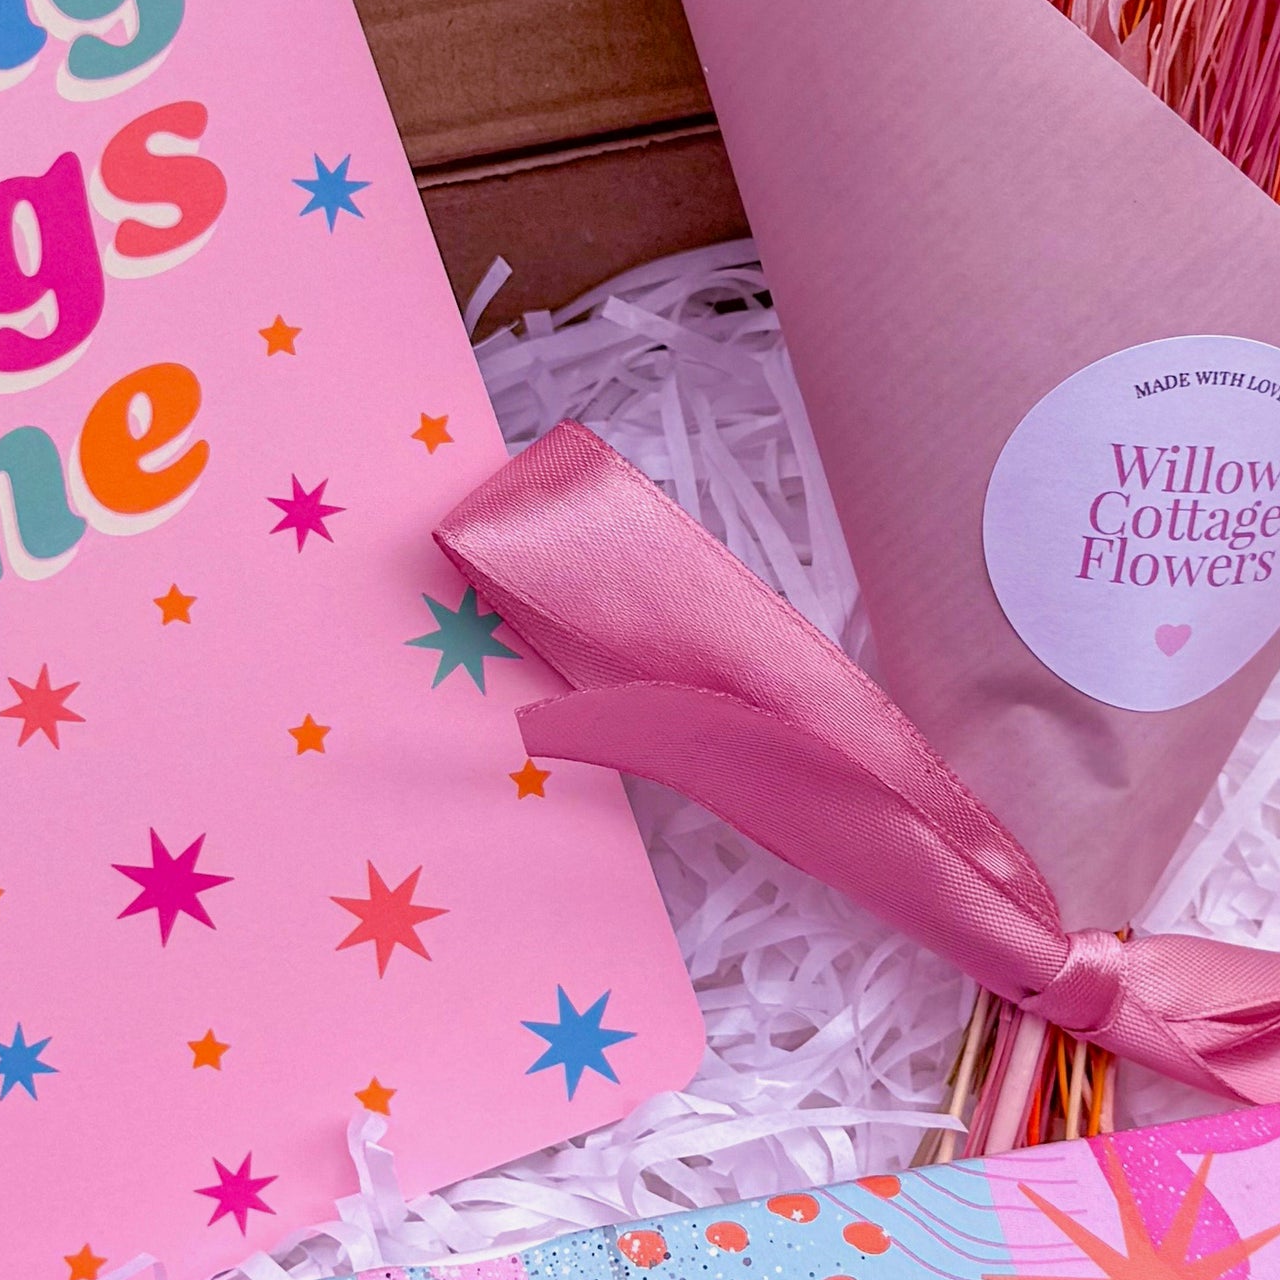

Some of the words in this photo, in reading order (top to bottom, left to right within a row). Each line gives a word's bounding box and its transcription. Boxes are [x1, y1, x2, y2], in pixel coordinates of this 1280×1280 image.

[1134, 372, 1190, 399] MADE
[1195, 370, 1246, 387] WITH
[1074, 535, 1276, 588] Flowers
